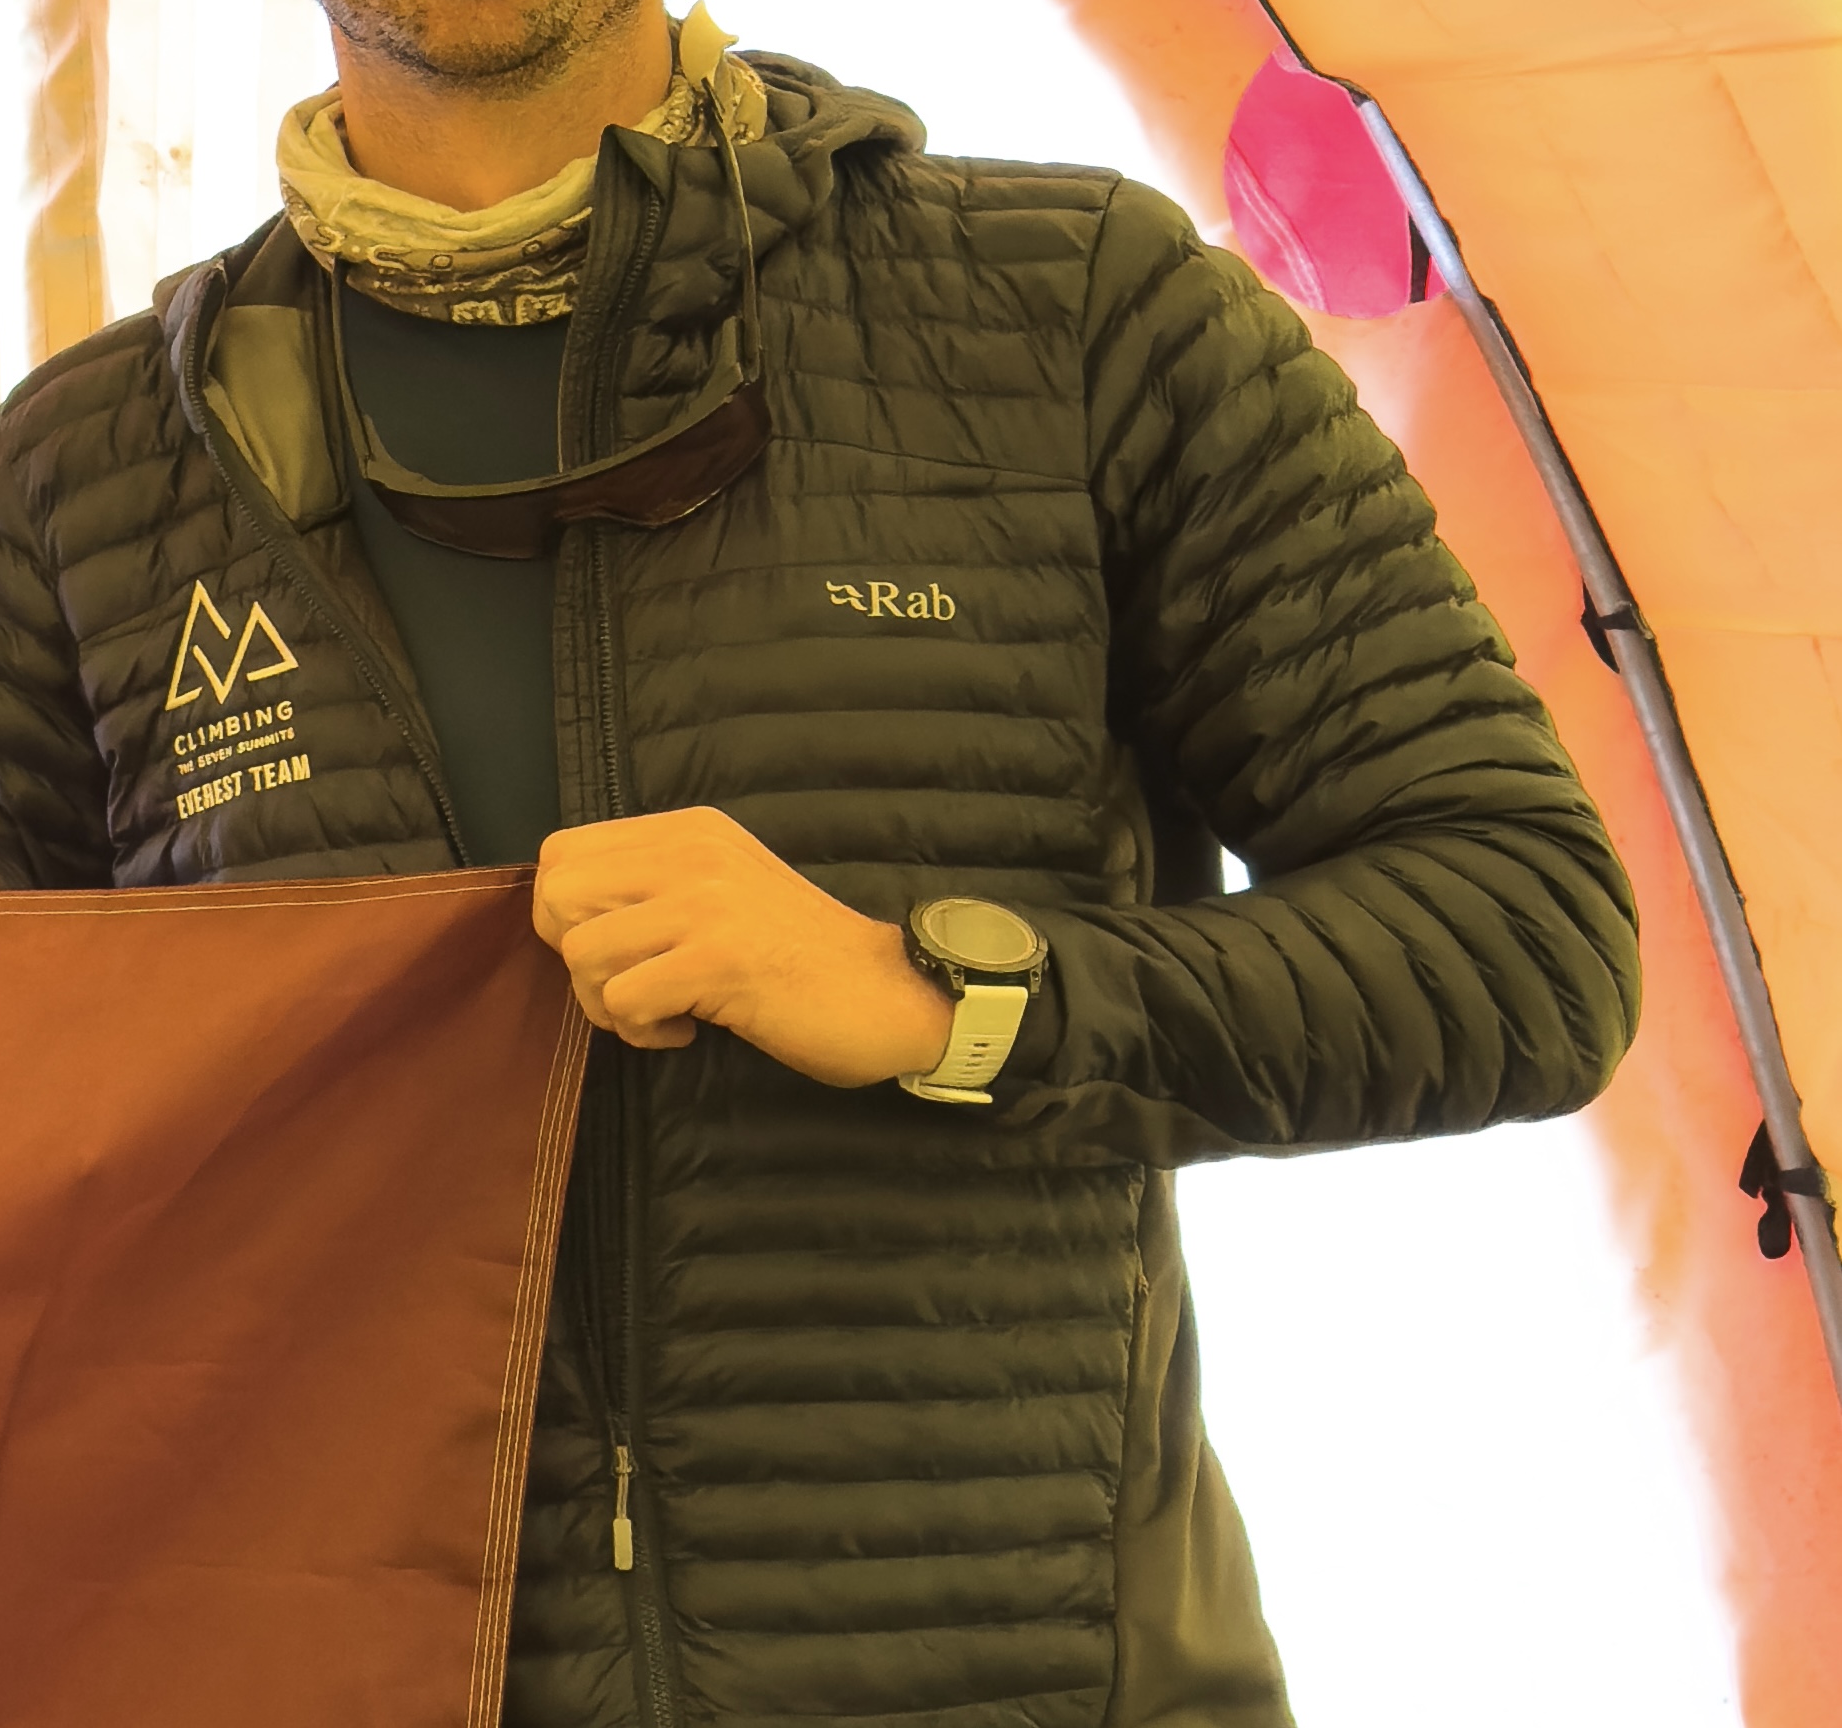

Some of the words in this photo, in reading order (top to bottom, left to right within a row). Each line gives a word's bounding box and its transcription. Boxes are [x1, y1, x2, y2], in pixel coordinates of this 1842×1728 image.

[866, 580, 957, 621] Rab
[174, 700, 294, 756] CLIMBING
[197, 745, 233, 769] SEVEN
[236, 726, 296, 755] SUMMITS
[176, 770, 245, 820] EVEREST
[247, 753, 312, 792] TEAM
